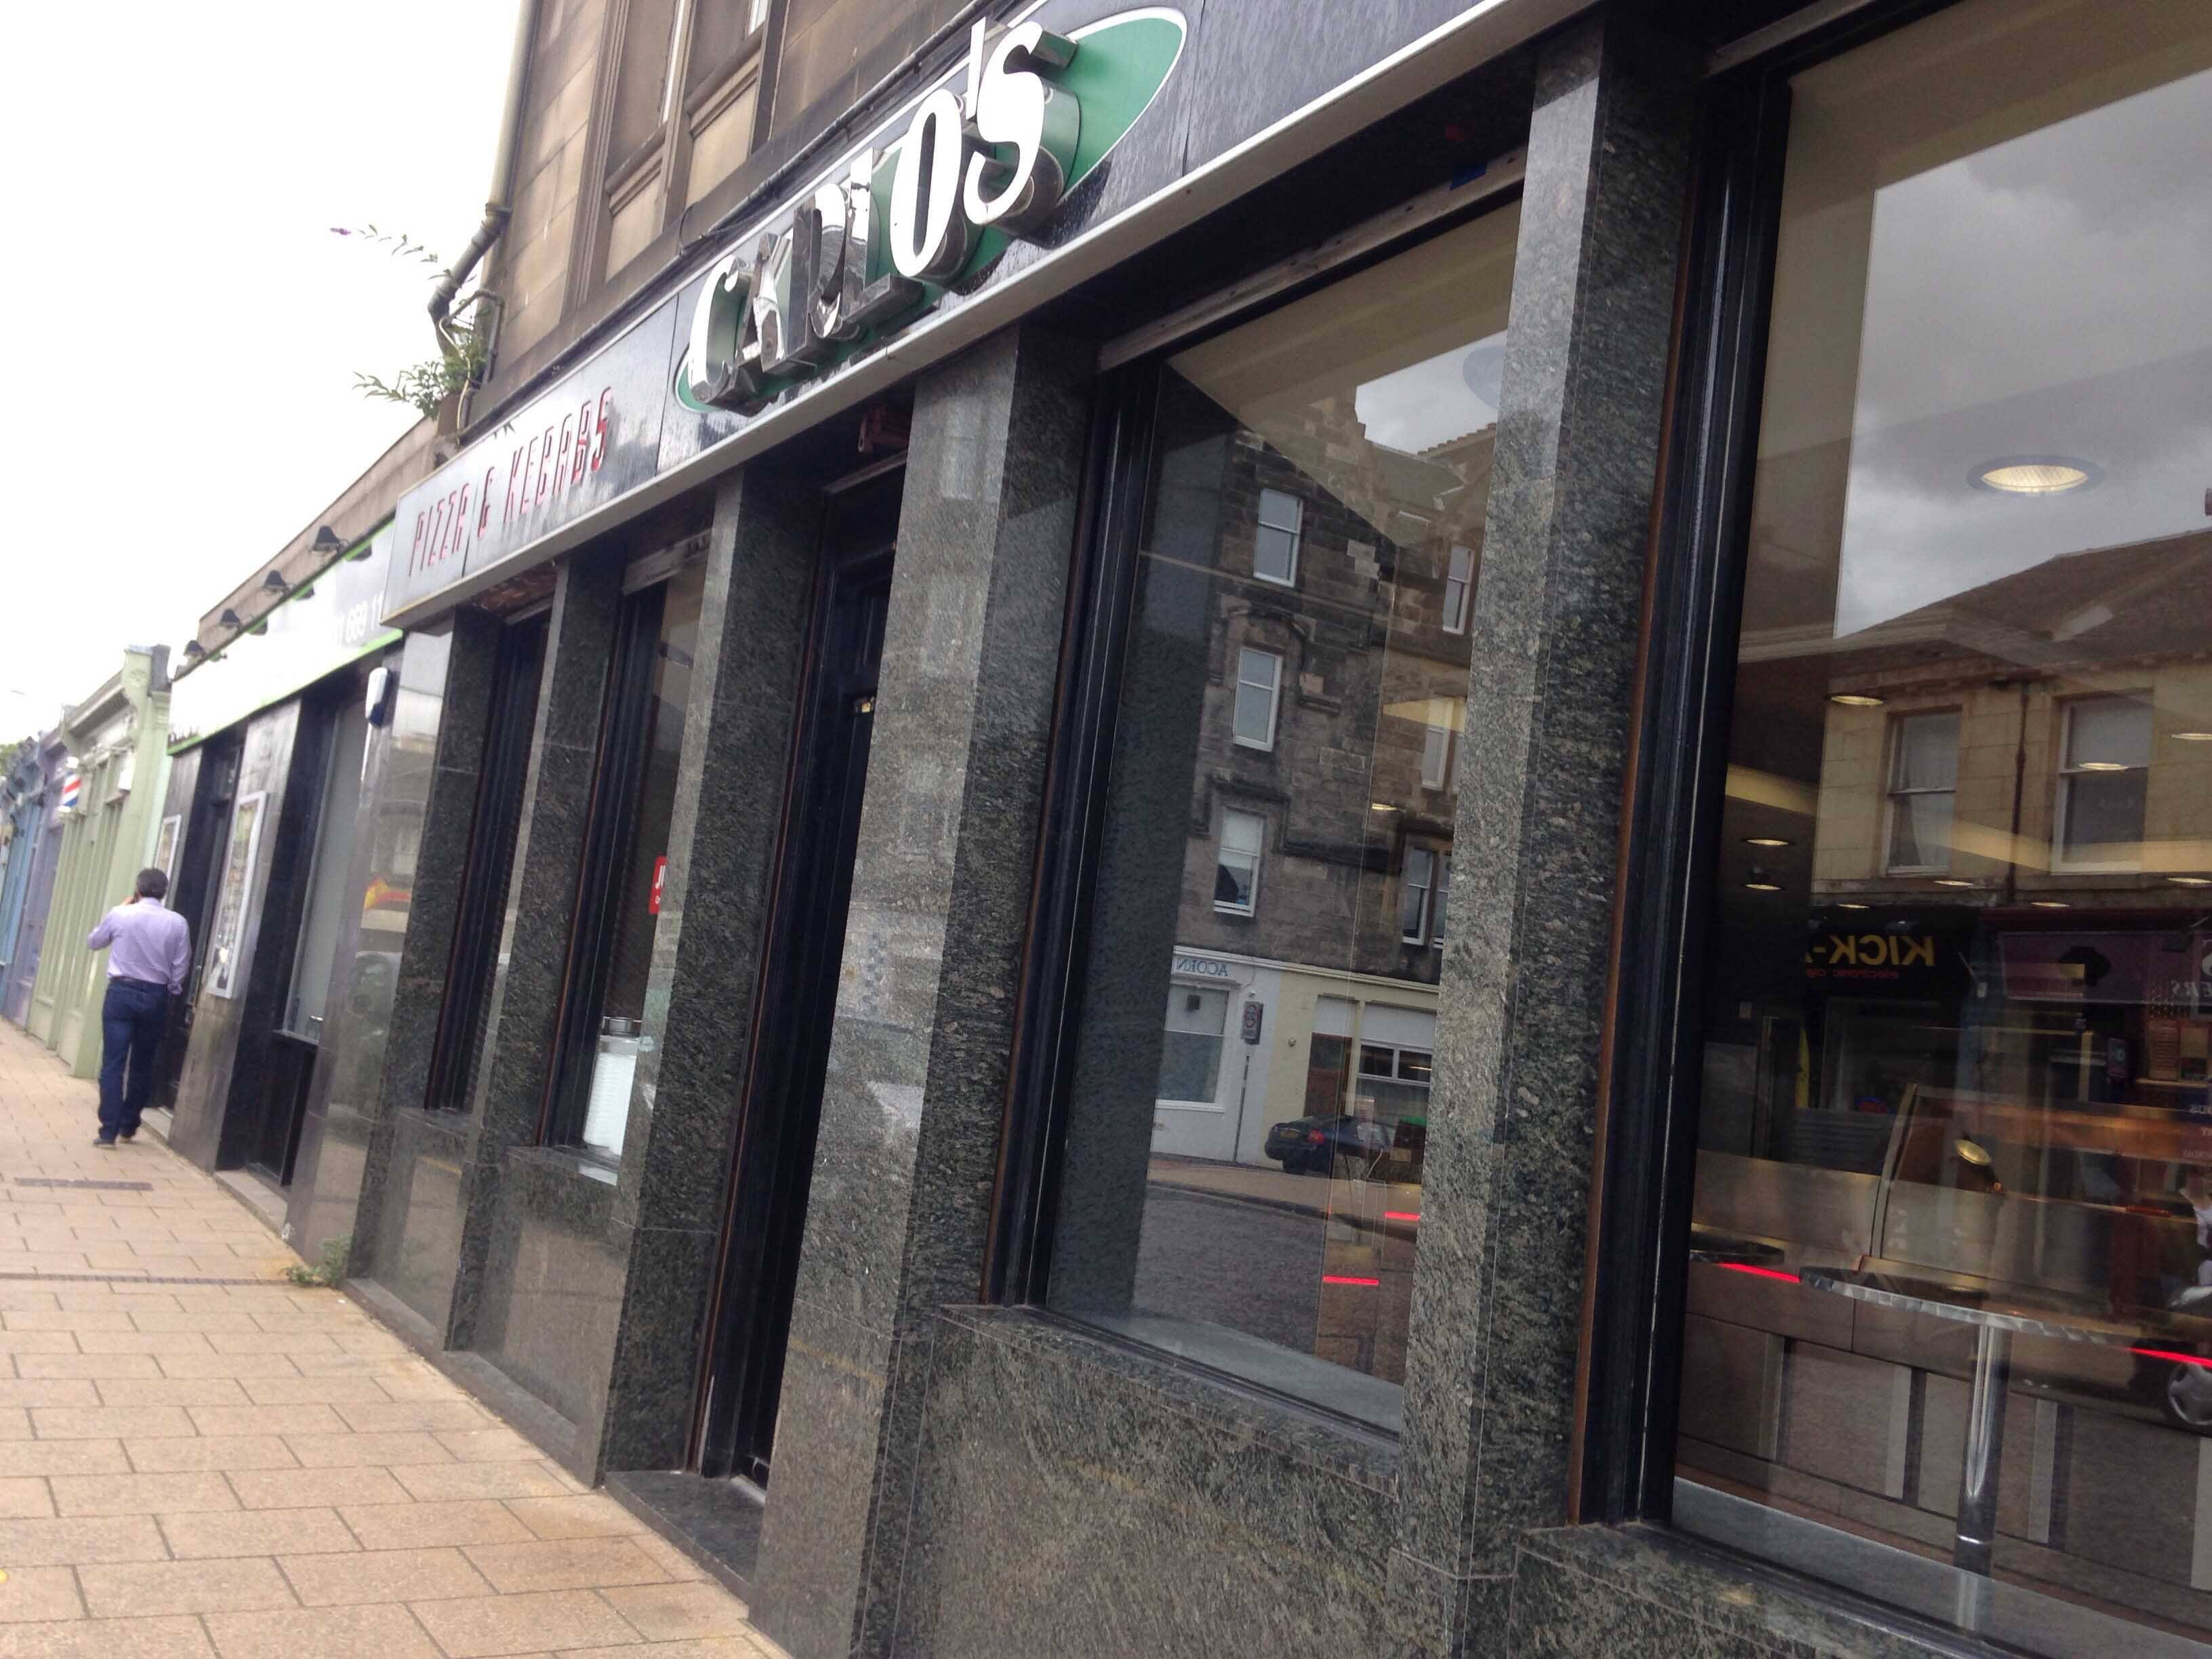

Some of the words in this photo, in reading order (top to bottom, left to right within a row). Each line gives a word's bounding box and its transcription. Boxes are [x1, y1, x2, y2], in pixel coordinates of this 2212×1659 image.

[690, 17, 1061, 408] CARLO'S
[409, 482, 472, 577] PIZZA
[503, 386, 612, 525] KEBABS
